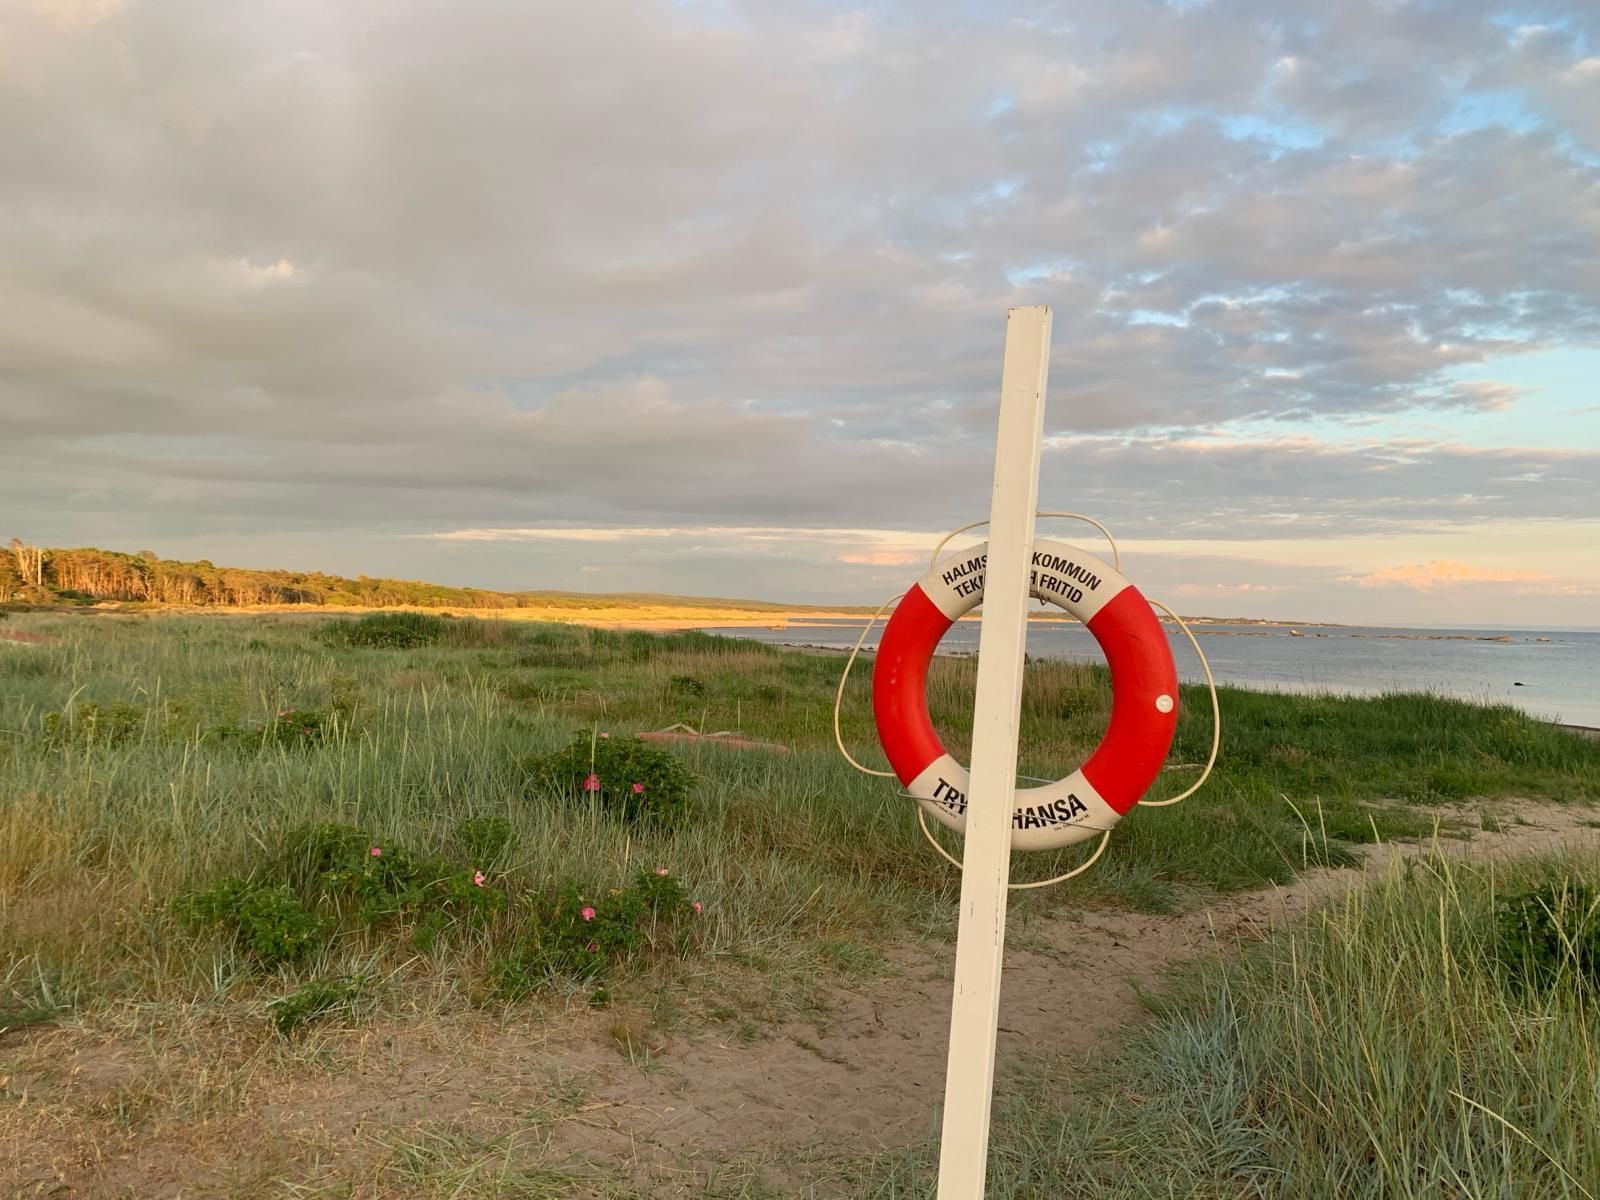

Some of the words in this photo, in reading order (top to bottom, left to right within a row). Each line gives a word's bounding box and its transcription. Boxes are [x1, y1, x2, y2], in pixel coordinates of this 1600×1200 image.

[942, 554, 988, 586] HALMS
[1032, 552, 1102, 591] KOMMUN
[1040, 574, 1083, 603] FRITID
[933, 777, 968, 815] TRY
[1012, 793, 1088, 829] HANSA
